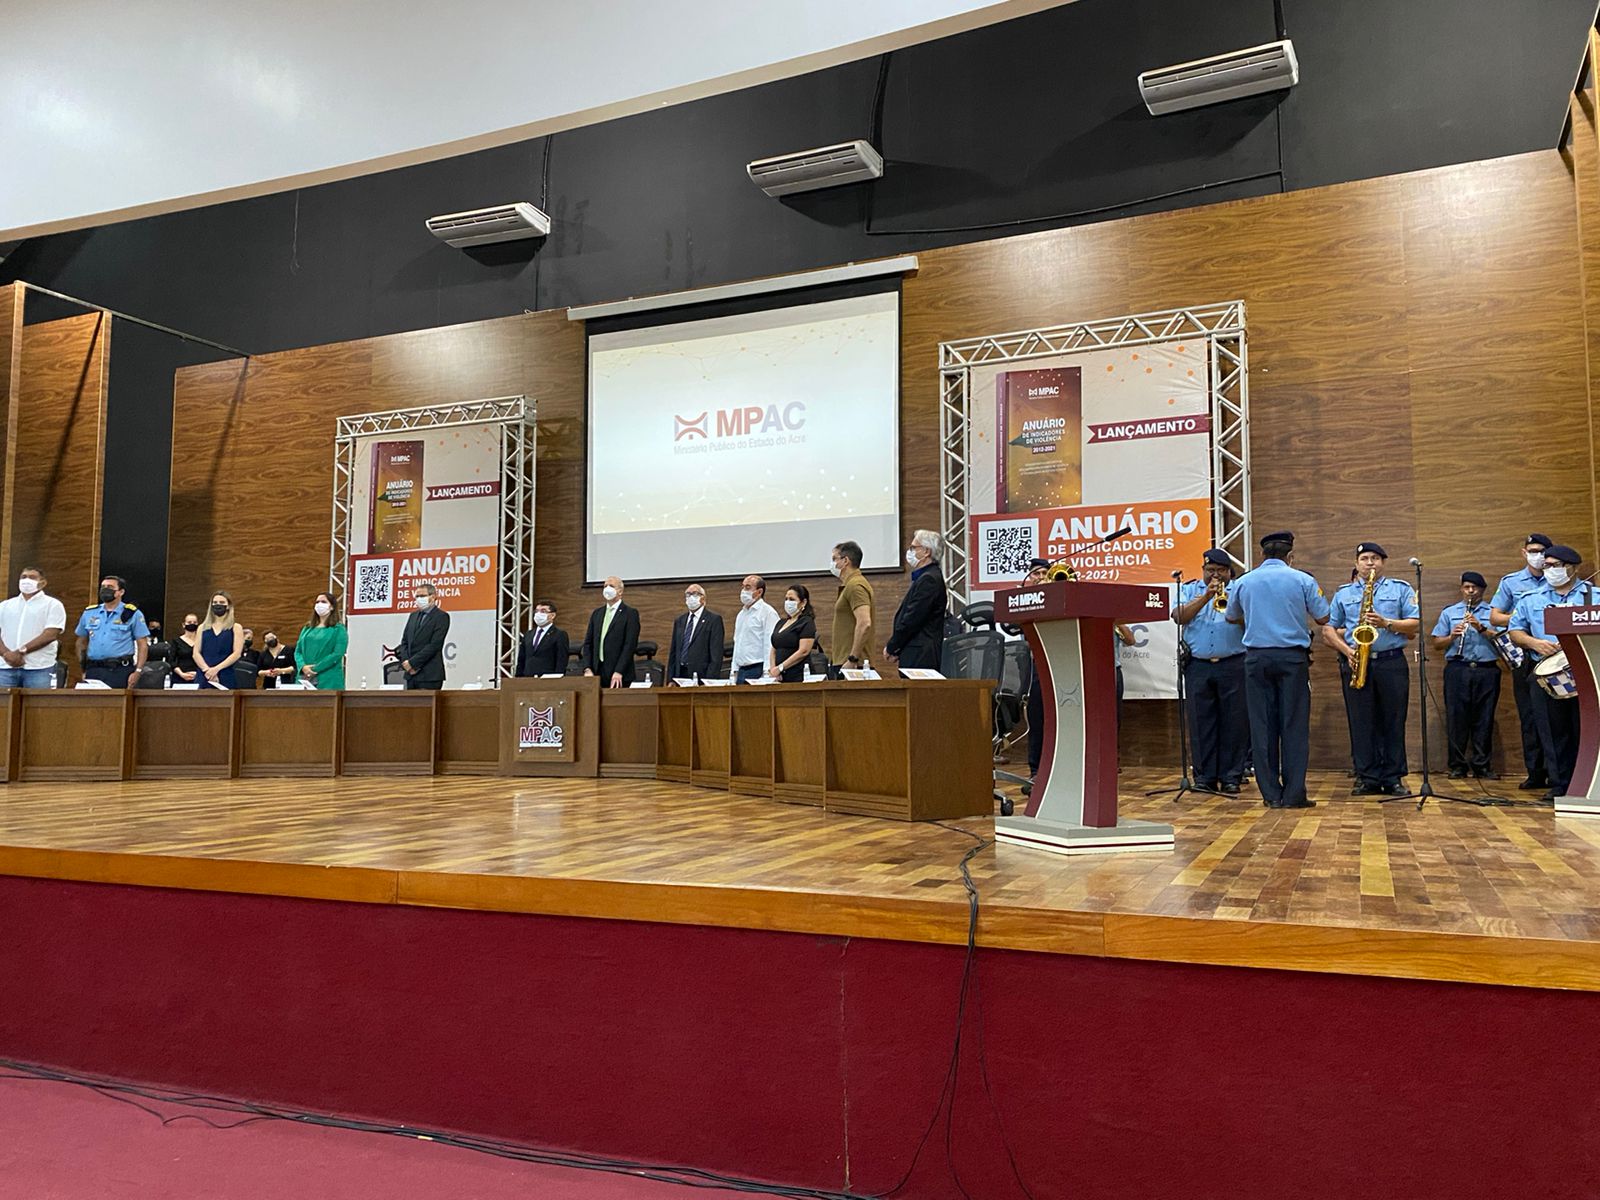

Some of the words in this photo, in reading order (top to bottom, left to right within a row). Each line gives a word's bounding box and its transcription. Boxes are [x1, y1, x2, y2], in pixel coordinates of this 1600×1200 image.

[1038, 386, 1060, 395] MPAC
[716, 401, 806, 438] MPAC
[1022, 417, 1066, 431] ANUÁRIO
[1097, 419, 1196, 439] LANÇAMENTO
[737, 440, 748, 449] do
[776, 435, 787, 446] do
[432, 484, 492, 498] LANÇAMENTO
[1048, 507, 1198, 541] ANUÁRIO
[1048, 544, 1067, 555] DE
[1071, 538, 1175, 555] INDICADORES
[399, 551, 491, 577] ANUÁRIO
[1071, 553, 1151, 568] VIOLÊNCIA
[397, 579, 410, 588] DE
[412, 575, 476, 588] INDICADORES
[397, 590, 410, 599] DE
[1019, 591, 1045, 606] MPAC
[1145, 600, 1164, 609] MPAC
[1133, 650, 1150, 659] Acre
[520, 726, 562, 742] MPAC
